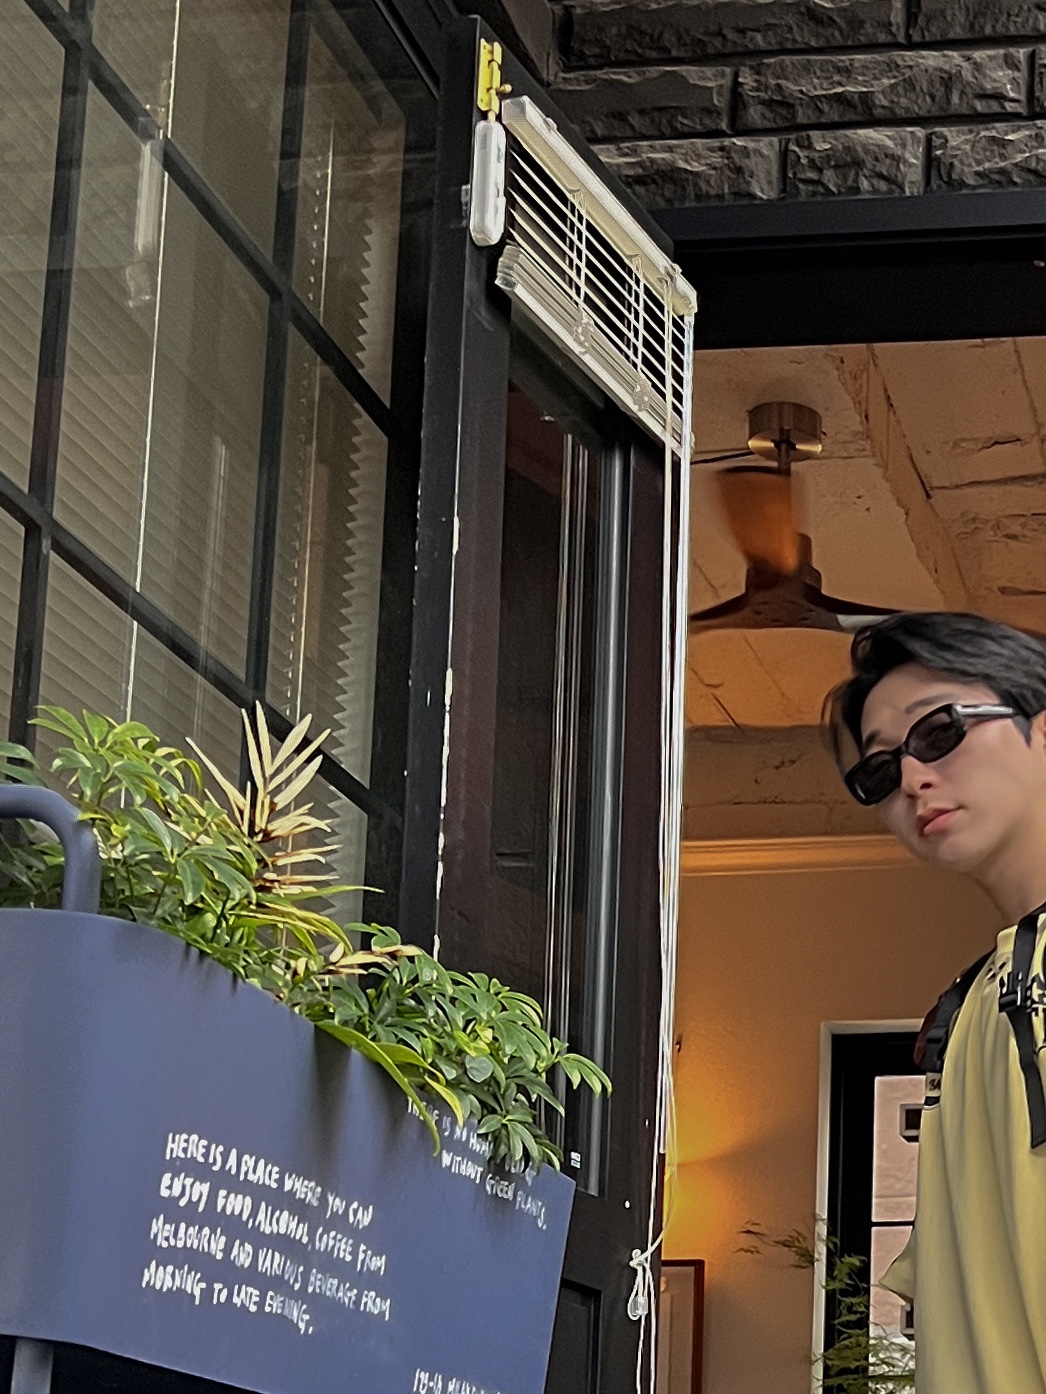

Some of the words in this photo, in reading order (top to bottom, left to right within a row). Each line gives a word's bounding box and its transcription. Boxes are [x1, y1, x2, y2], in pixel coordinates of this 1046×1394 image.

[160, 1172, 211, 1213] ENJOY
[315, 1226, 354, 1262] COFFEE
[356, 1243, 386, 1276] FROM
[165, 1132, 208, 1163] HERE
[208, 1143, 224, 1171] IS
[225, 1147, 238, 1175] A
[239, 1154, 280, 1189] PLACE
[284, 1171, 322, 1207] WHERE
[325, 1191, 346, 1220] YOU
[349, 1201, 373, 1230] CAN
[441, 1150, 484, 1184] WITHOUT
[485, 1173, 516, 1202] GREEN
[141, 1259, 207, 1305] MORNING
[212, 1282, 228, 1305] TO
[232, 1284, 260, 1313] LATE
[150, 1213, 227, 1260] MELBOURNE
[230, 1238, 254, 1269] AND
[257, 1246, 304, 1291] VARIOUS
[307, 1268, 358, 1310] BEVERAGE
[360, 1290, 391, 1321] FROM
